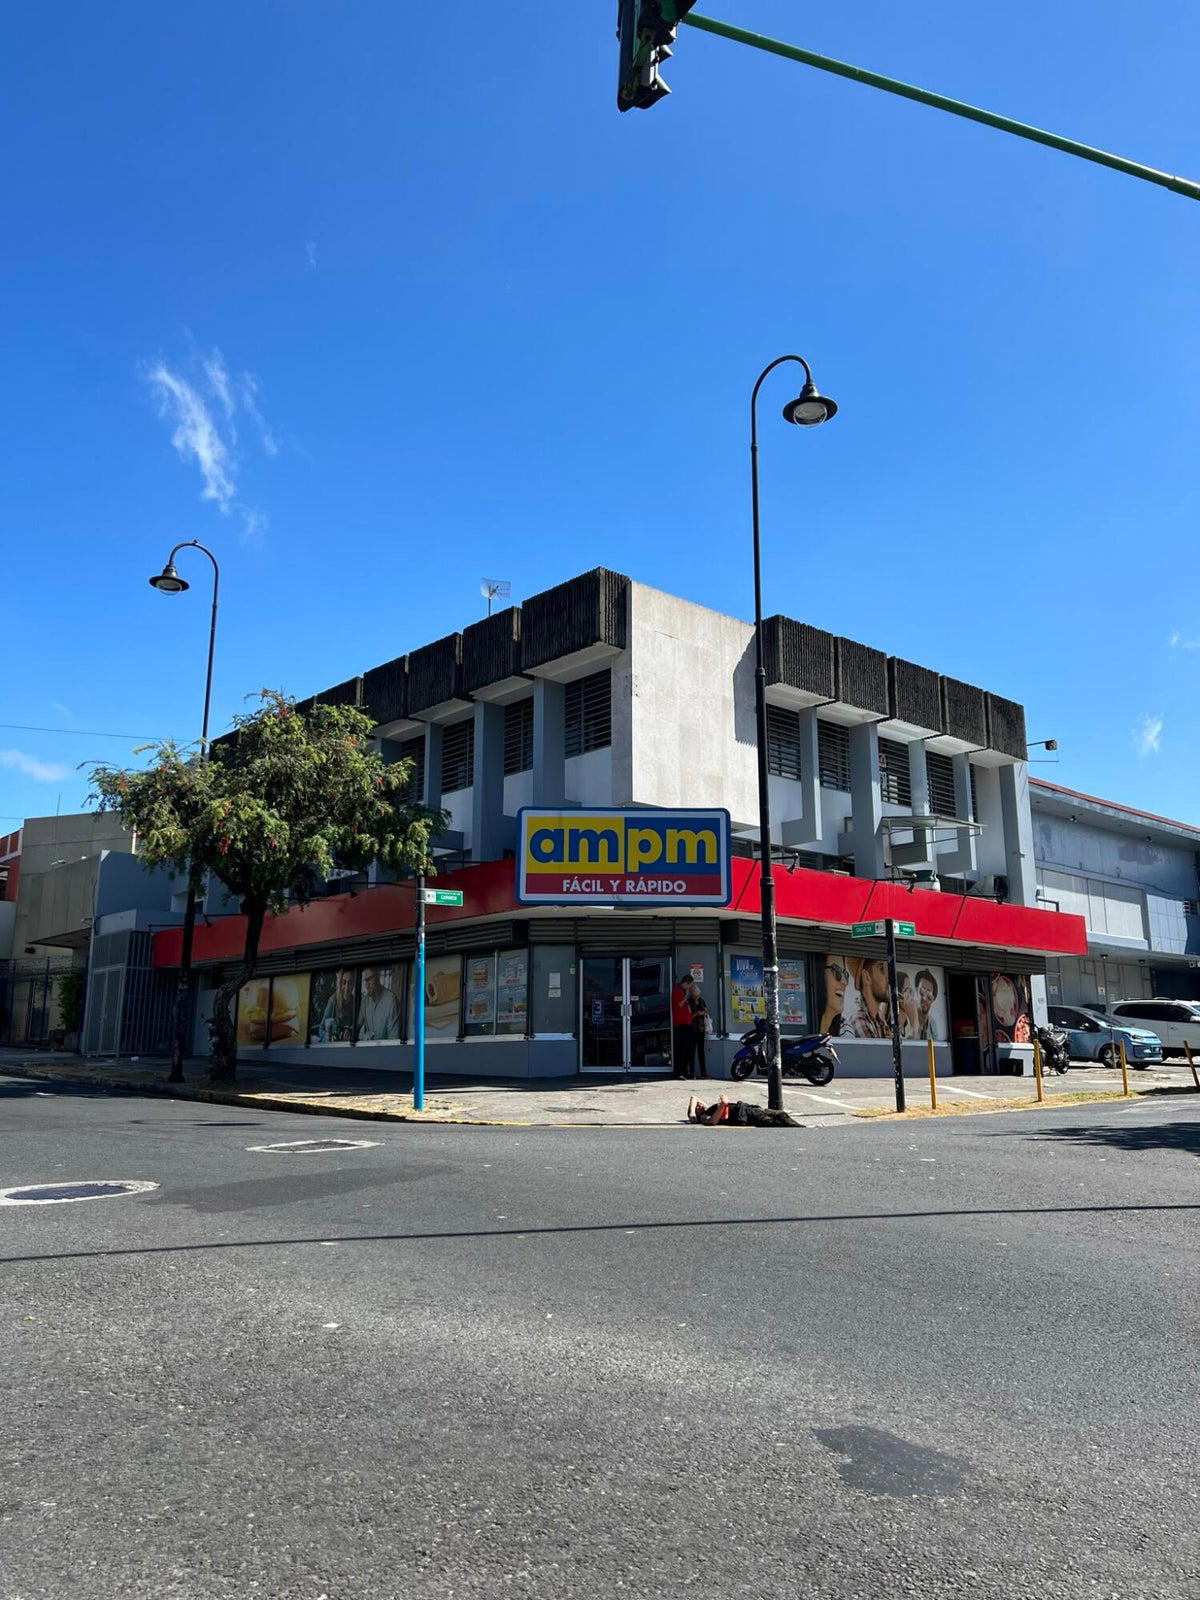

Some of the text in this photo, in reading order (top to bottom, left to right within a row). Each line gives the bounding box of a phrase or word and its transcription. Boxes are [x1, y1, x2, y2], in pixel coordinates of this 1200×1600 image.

[562, 876, 687, 893] FÁCIL Y RÁPIDO
